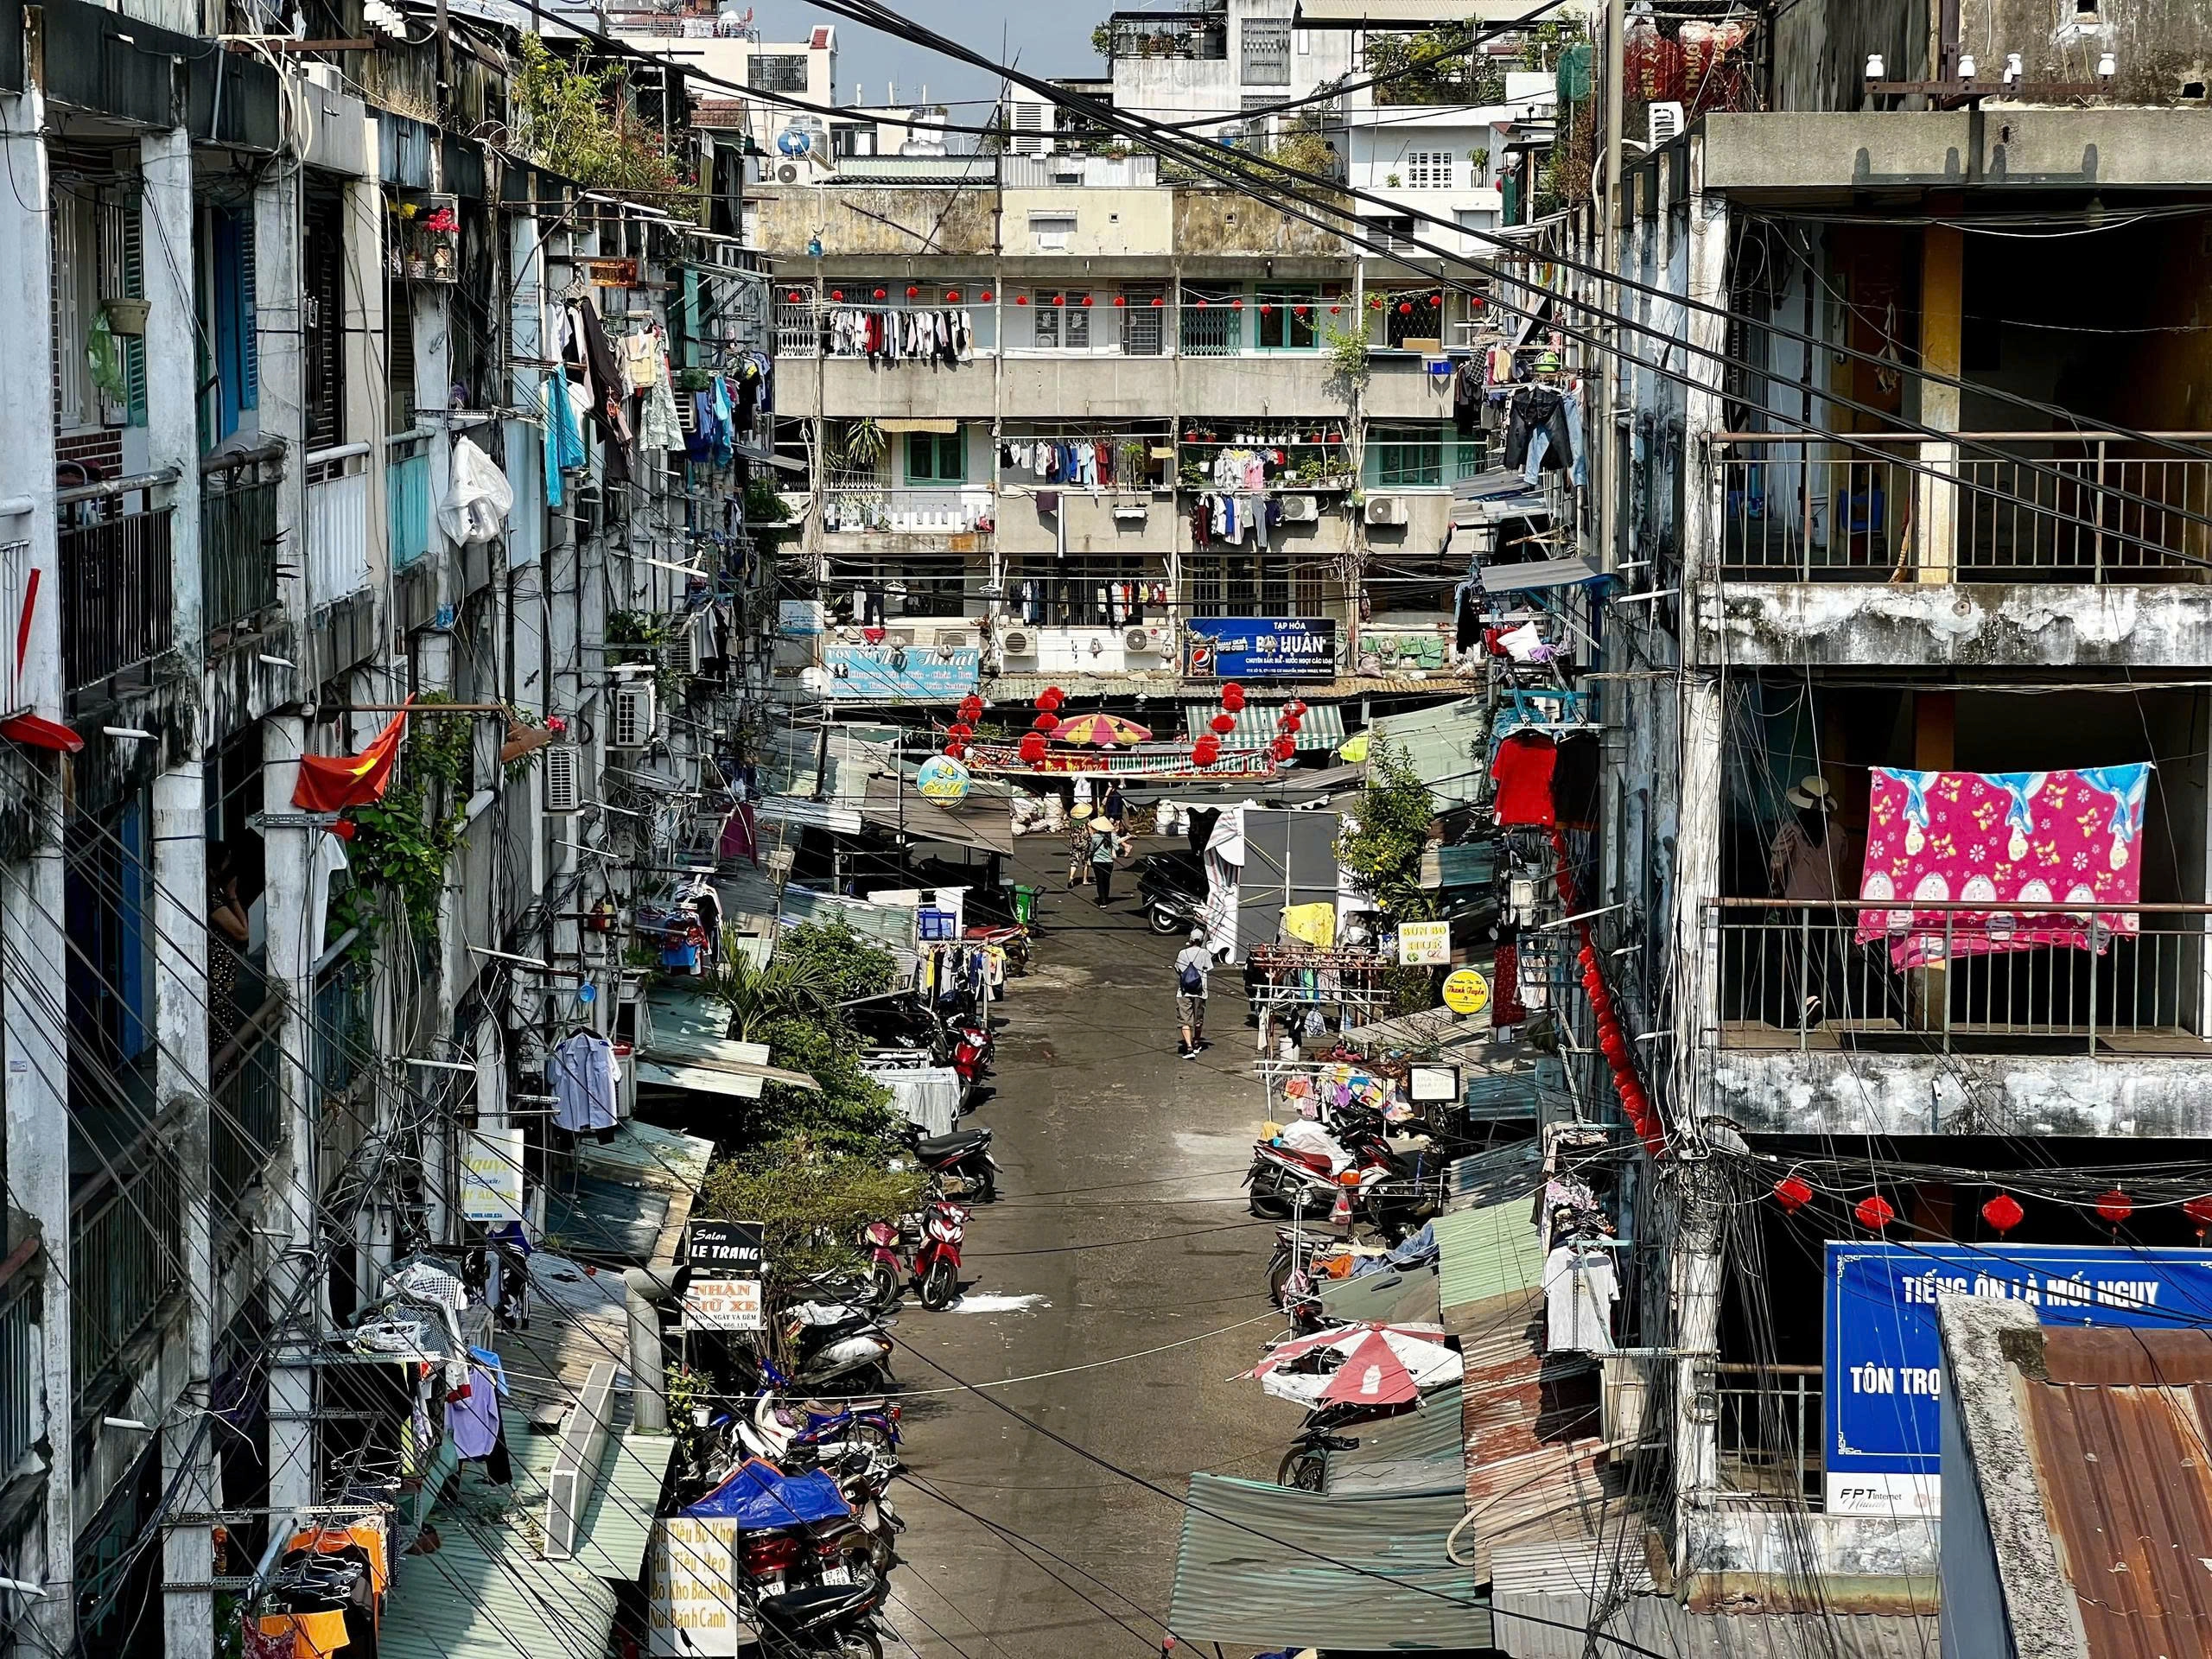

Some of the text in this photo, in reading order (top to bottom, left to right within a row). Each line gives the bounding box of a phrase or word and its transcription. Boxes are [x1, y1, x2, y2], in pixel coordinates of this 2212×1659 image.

[1273, 620, 1306, 632] TẠP HÓA
[1281, 632, 1324, 653] HUÂN
[692, 1229, 727, 1241] Salon
[691, 1245, 759, 1261] LE TRANG
[694, 1282, 751, 1298] NHẬN
[2097, 1281, 2158, 1308] NGUY
[729, 1300, 759, 1313] XE
[1850, 1362, 1894, 1394] TÔN
[1840, 1489, 1877, 1499] FPT
[712, 1522, 734, 1544] Kho
[703, 1552, 726, 1573] Heo
[669, 1580, 689, 1600] Kho
[671, 1608, 698, 1629] Bánh
[700, 1608, 726, 1629] Canh
